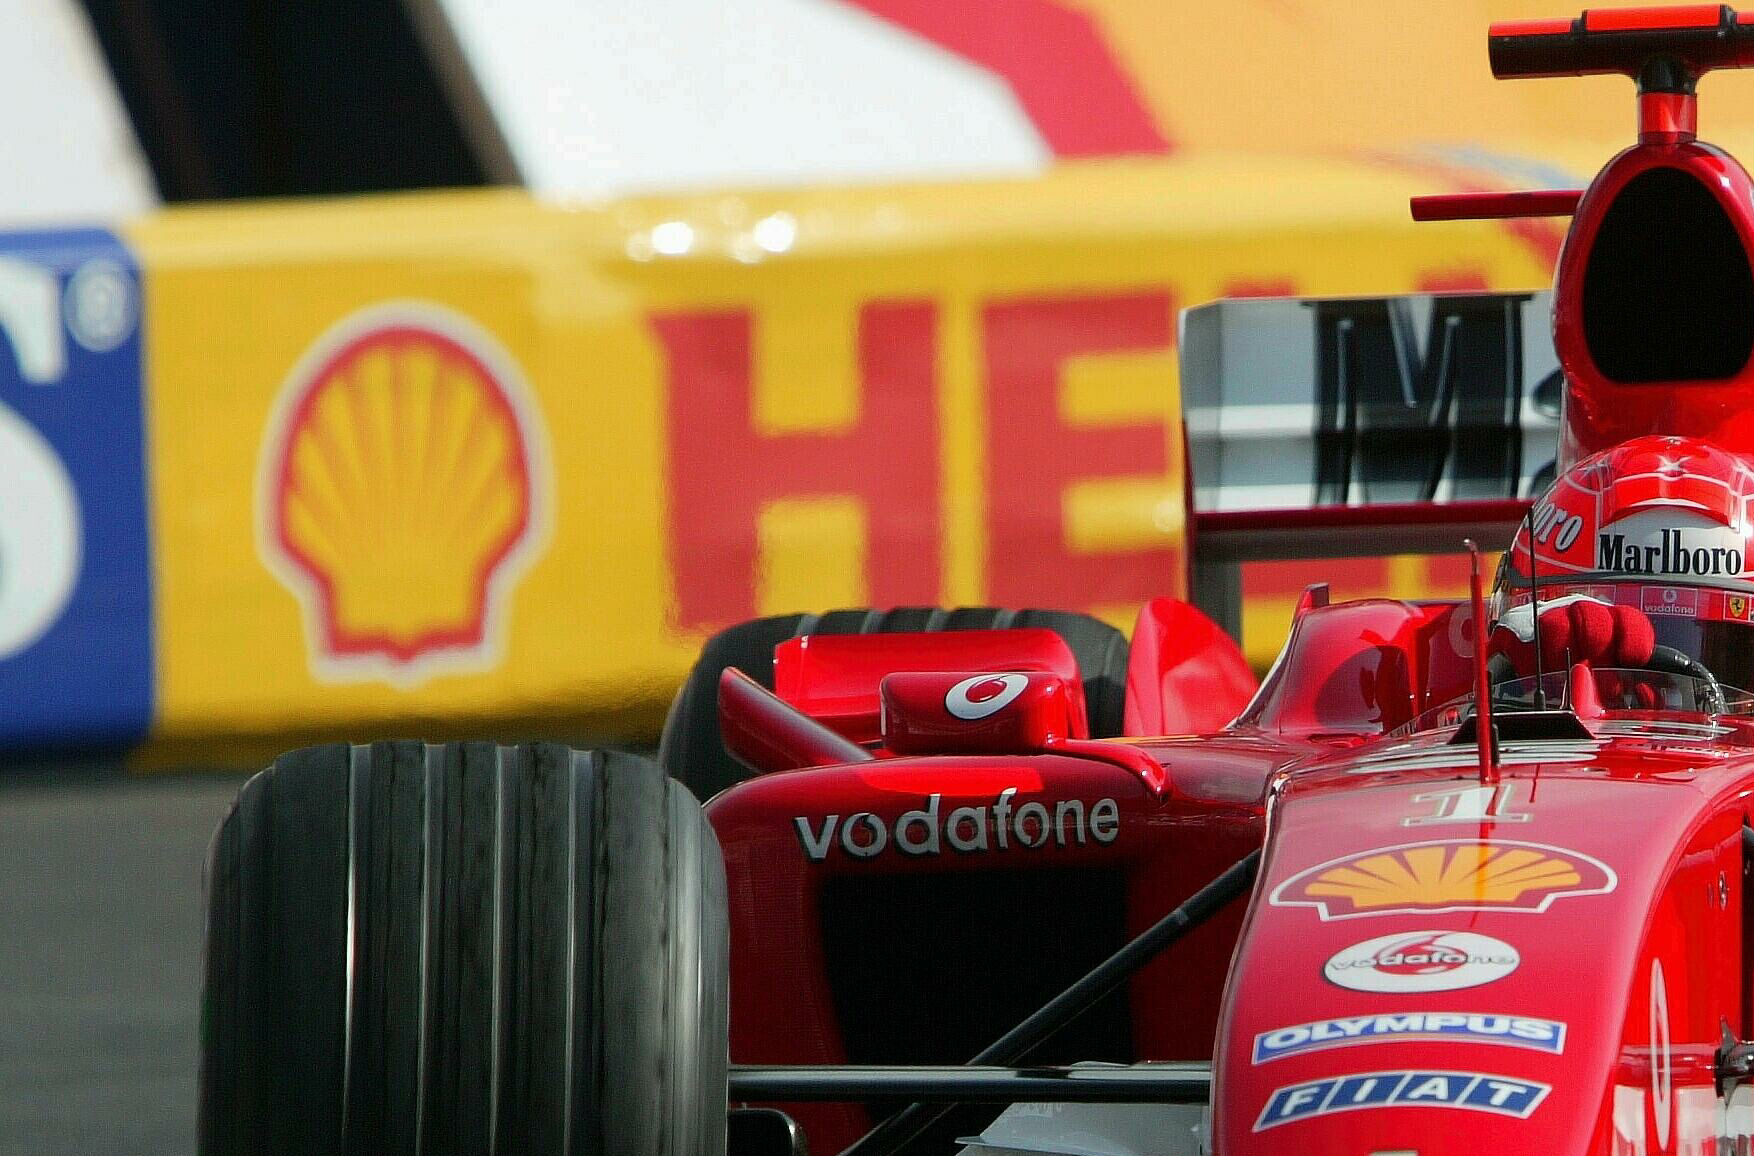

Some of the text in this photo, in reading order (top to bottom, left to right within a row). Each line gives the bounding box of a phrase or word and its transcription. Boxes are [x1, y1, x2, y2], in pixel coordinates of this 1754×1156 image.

[1598, 528, 1742, 576] Marlboro
[795, 786, 1120, 863] vodafone
[1262, 1013, 1554, 1052] OLYMPUS
[1281, 1075, 1520, 1117] FIAT
